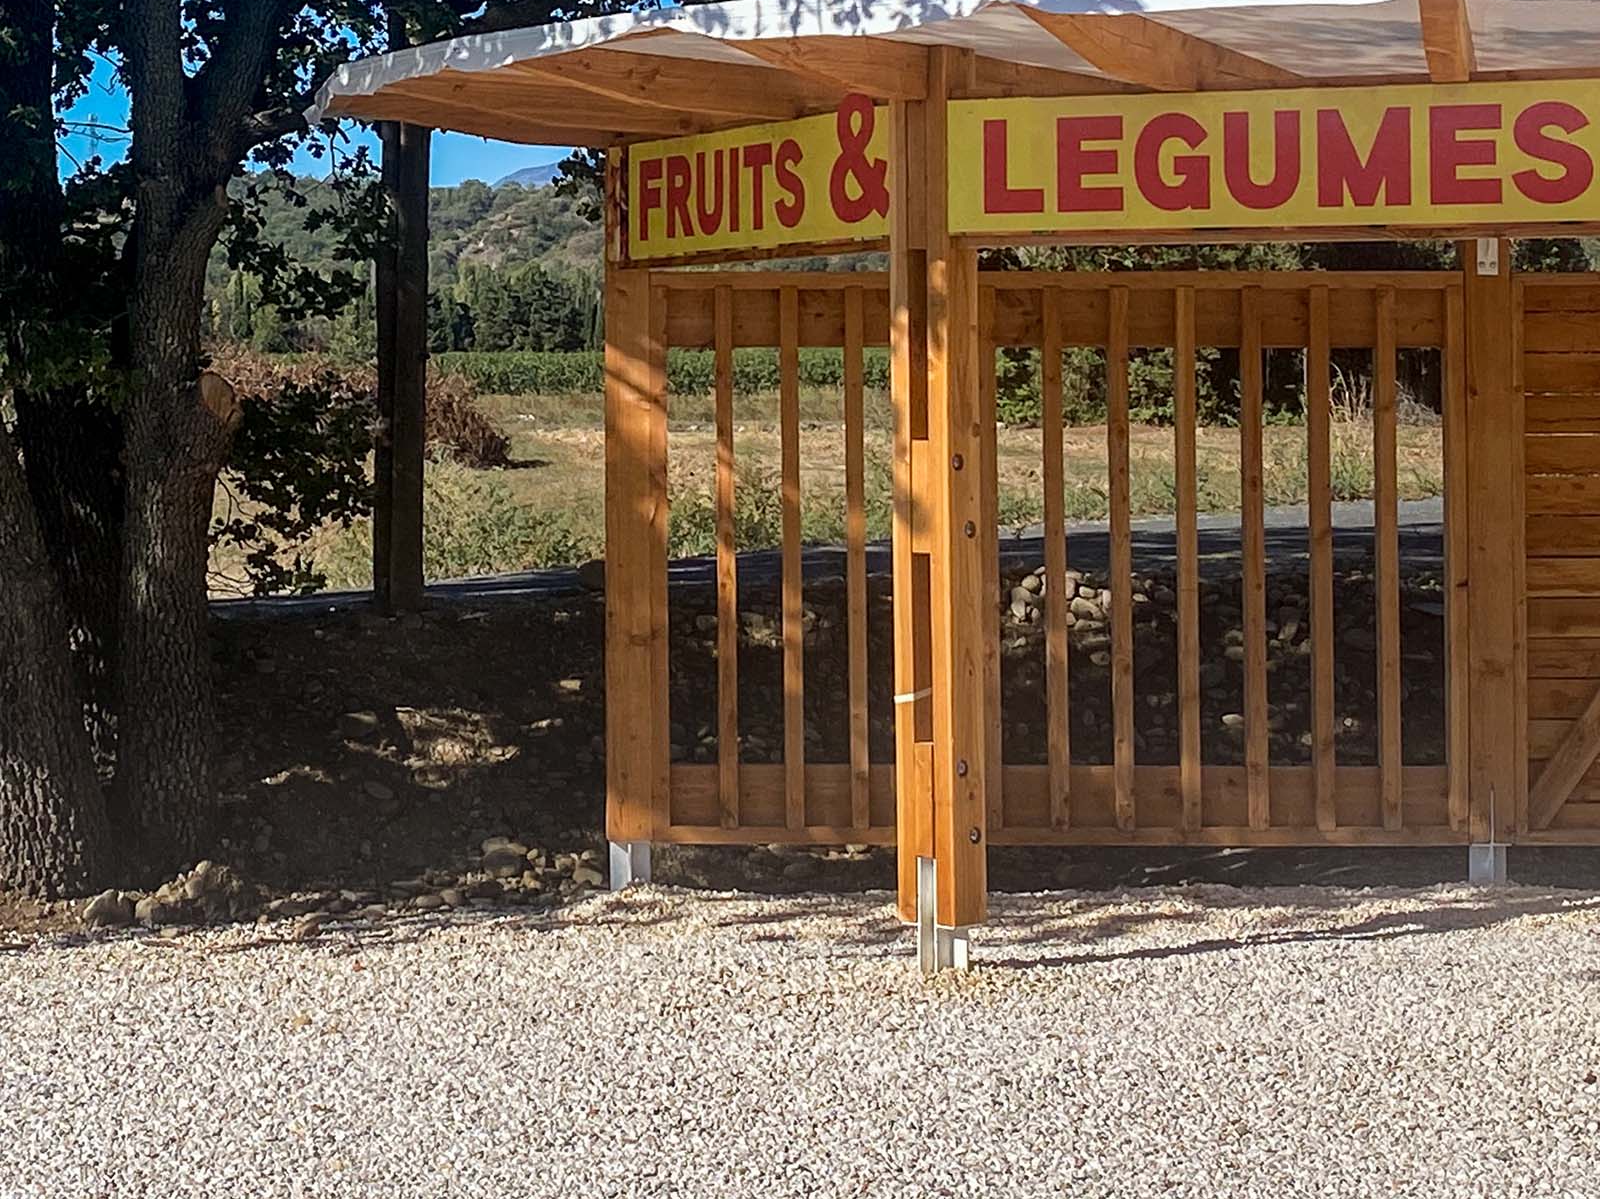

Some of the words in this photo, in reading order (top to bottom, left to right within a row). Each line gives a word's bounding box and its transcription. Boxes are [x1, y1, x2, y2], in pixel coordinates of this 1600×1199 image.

[639, 139, 805, 241] FRUITS
[829, 92, 890, 224] &
[983, 101, 1594, 214] LEGUMES
